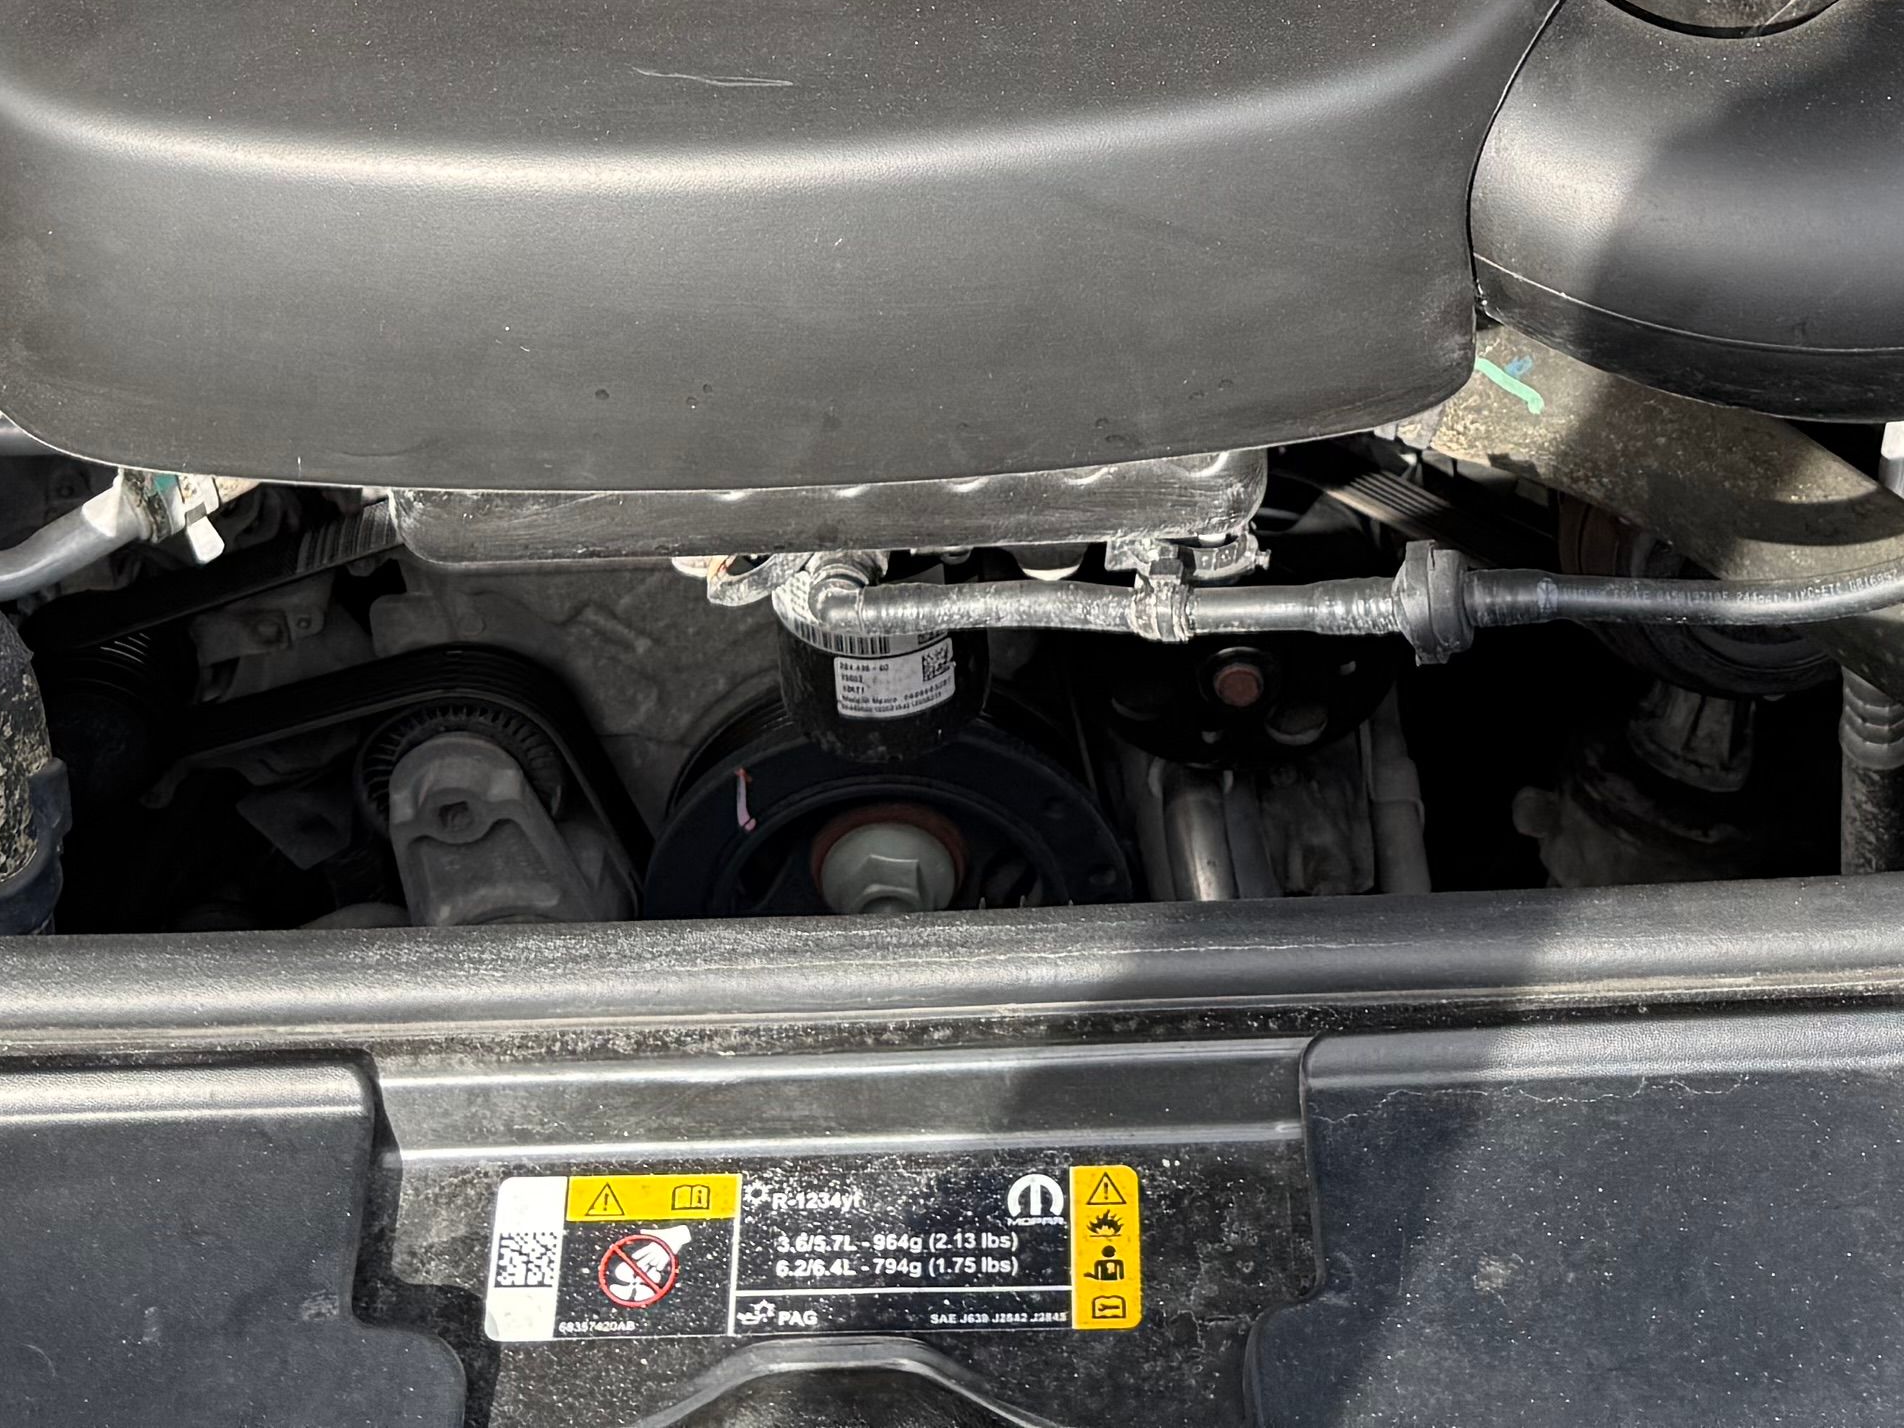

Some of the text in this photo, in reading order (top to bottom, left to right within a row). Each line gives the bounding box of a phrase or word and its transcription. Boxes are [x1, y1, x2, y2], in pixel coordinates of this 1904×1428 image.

[772, 1191, 864, 1213] R-1234yf
[776, 1234, 858, 1253] 3.6/5.7L
[873, 1233, 923, 1253] 964g
[928, 1232, 977, 1253] (2.13
[981, 1231, 1019, 1252] lbs)
[775, 1258, 857, 1278] 6.2/6.4L
[872, 1258, 923, 1278] 794g
[928, 1256, 977, 1277] (1.75
[981, 1256, 1019, 1276] lbs)
[777, 1310, 819, 1327] PAG
[930, 1313, 957, 1324] SAE
